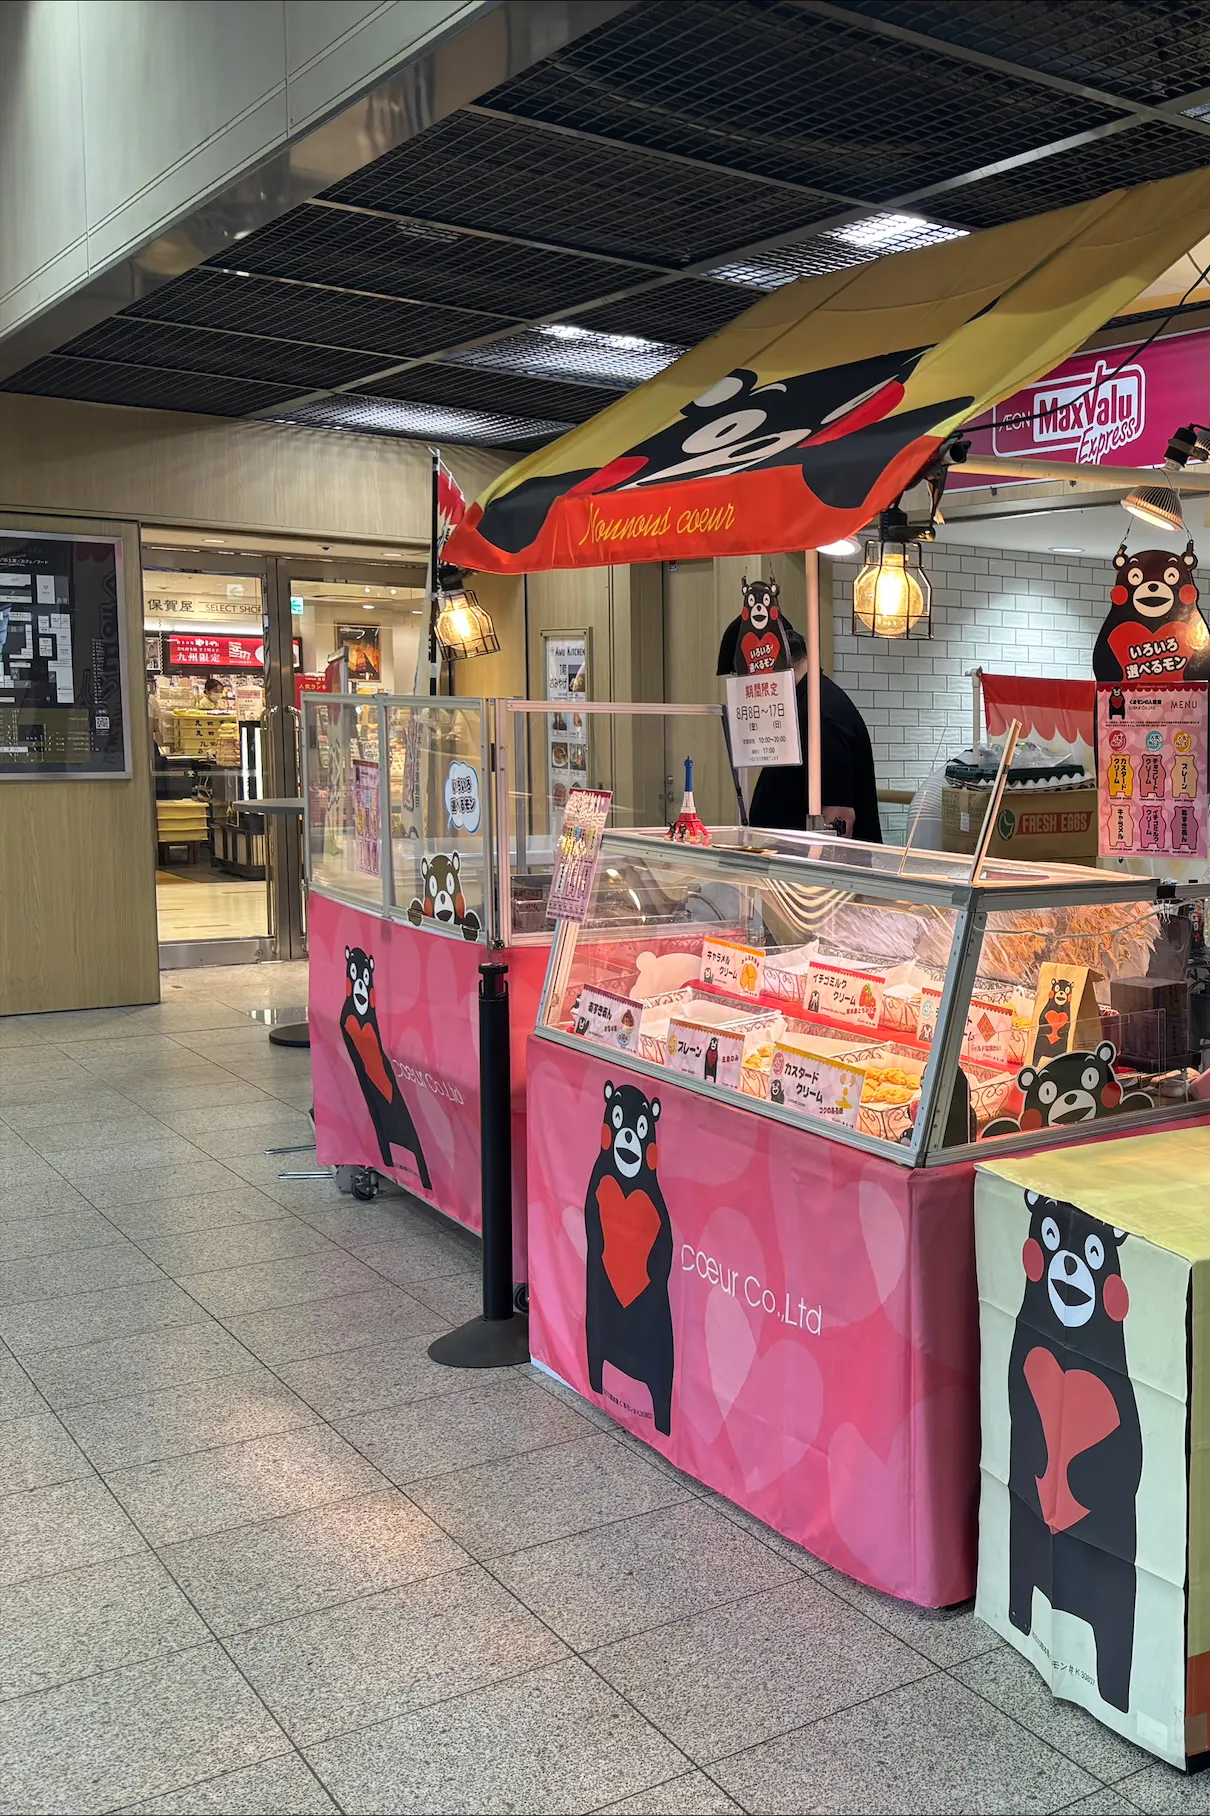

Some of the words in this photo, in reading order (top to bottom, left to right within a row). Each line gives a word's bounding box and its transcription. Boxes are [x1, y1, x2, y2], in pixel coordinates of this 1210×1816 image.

[1038, 365, 1133, 435] MaxValu
[1079, 416, 1137, 464] Express
[676, 503, 736, 534] coeur
[206, 603, 236, 613] SELECT
[177, 652, 221, 663] 九州限定
[749, 643, 773, 659] いろいろ
[1129, 638, 1179, 661] いろいろ
[1125, 656, 1188, 681] 選べるモン
[745, 682, 779, 699] 期間限定
[1170, 700, 1198, 710] MENU
[1113, 758, 1121, 785] クリーム
[1022, 814, 1057, 833] FRESH
[1061, 813, 1088, 832] EGGS
[719, 966, 738, 980] クリーム
[813, 973, 847, 990] イチゴミルク
[833, 991, 856, 1006] クリーム
[784, 1063, 819, 1084] カスタード
[796, 1083, 823, 1103] クリーム
